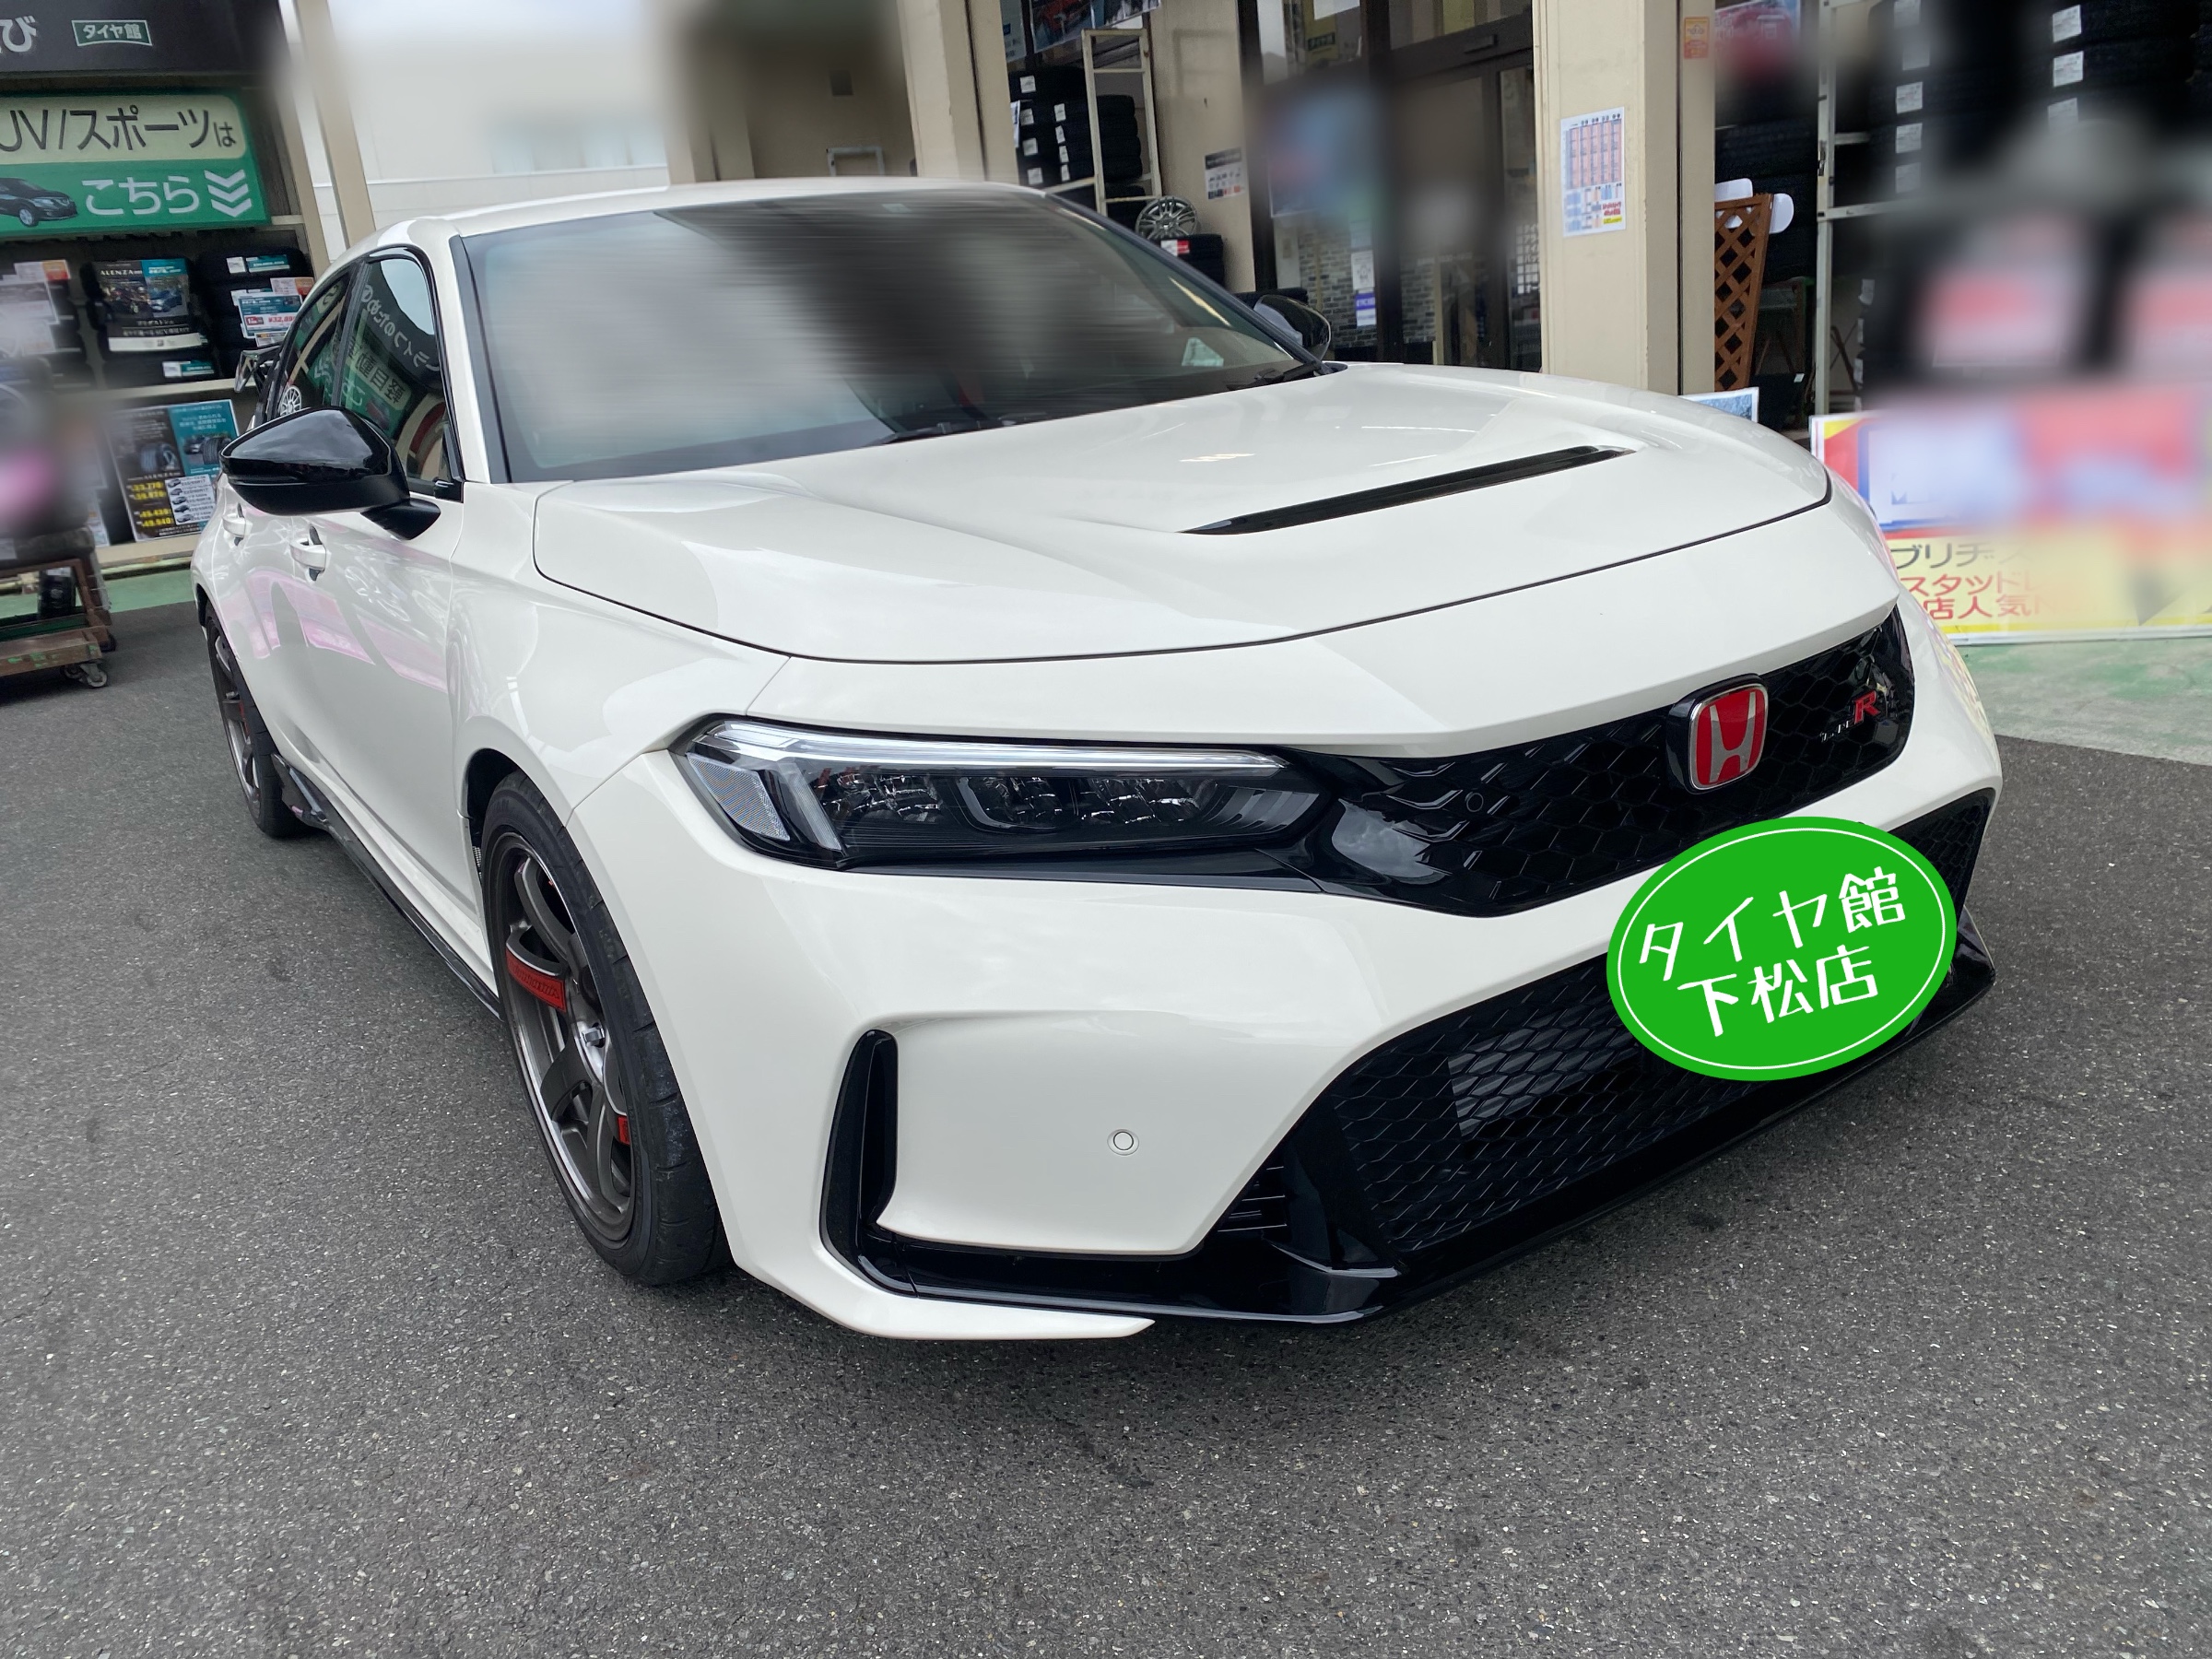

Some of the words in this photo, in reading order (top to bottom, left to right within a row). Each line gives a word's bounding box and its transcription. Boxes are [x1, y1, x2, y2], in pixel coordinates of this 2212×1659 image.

[83, 24, 142, 39] タイヤ館
[82, 177, 200, 215] こちら
